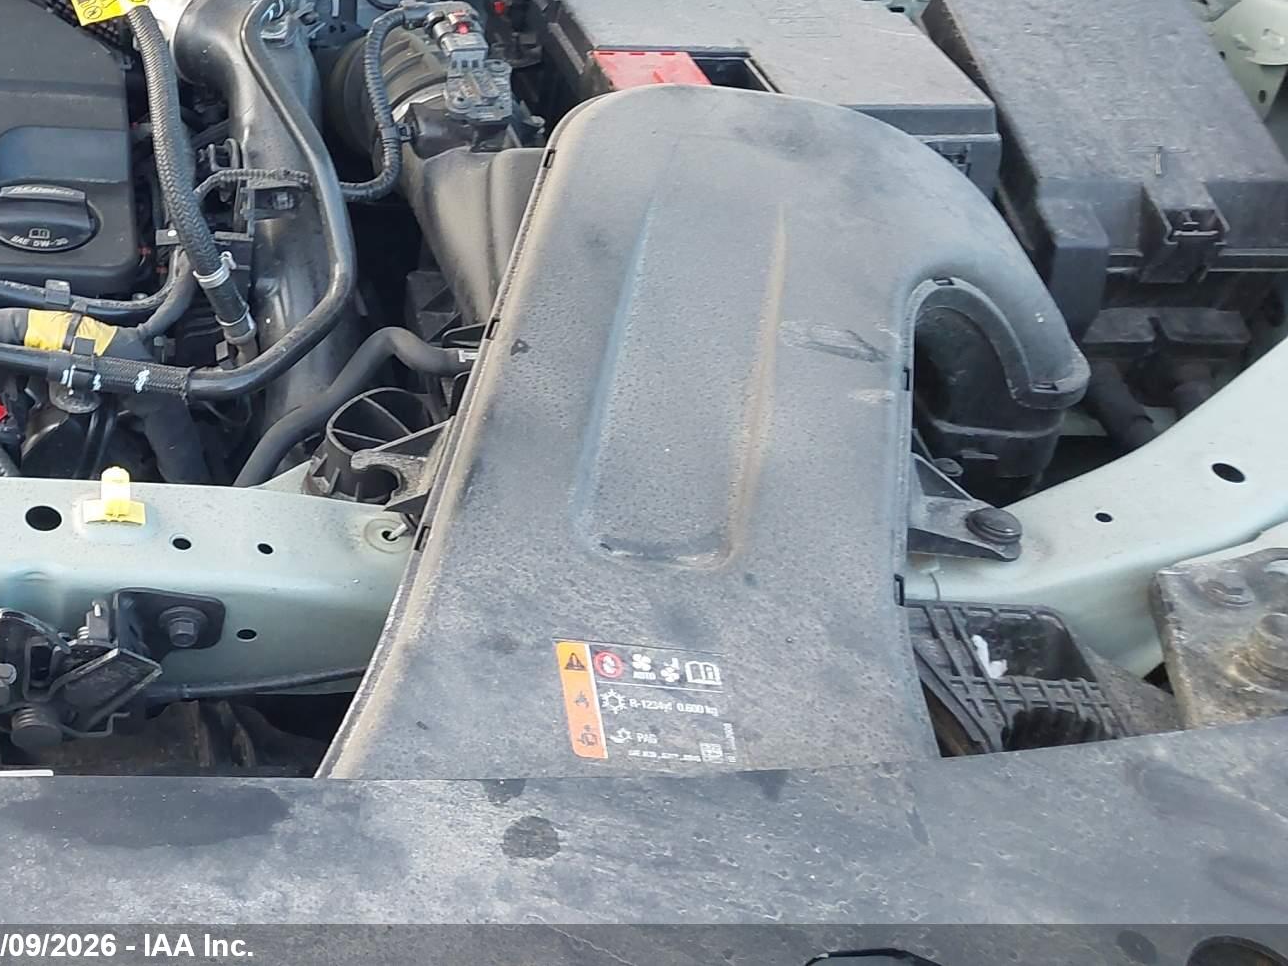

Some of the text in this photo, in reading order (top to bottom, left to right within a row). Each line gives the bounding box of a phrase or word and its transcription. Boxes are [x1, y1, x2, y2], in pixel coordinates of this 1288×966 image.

[10, 235, 31, 246] SAE
[629, 698, 673, 713] R-1234yf
[704, 705, 719, 717] kg
[636, 732, 658, 744] PAG
